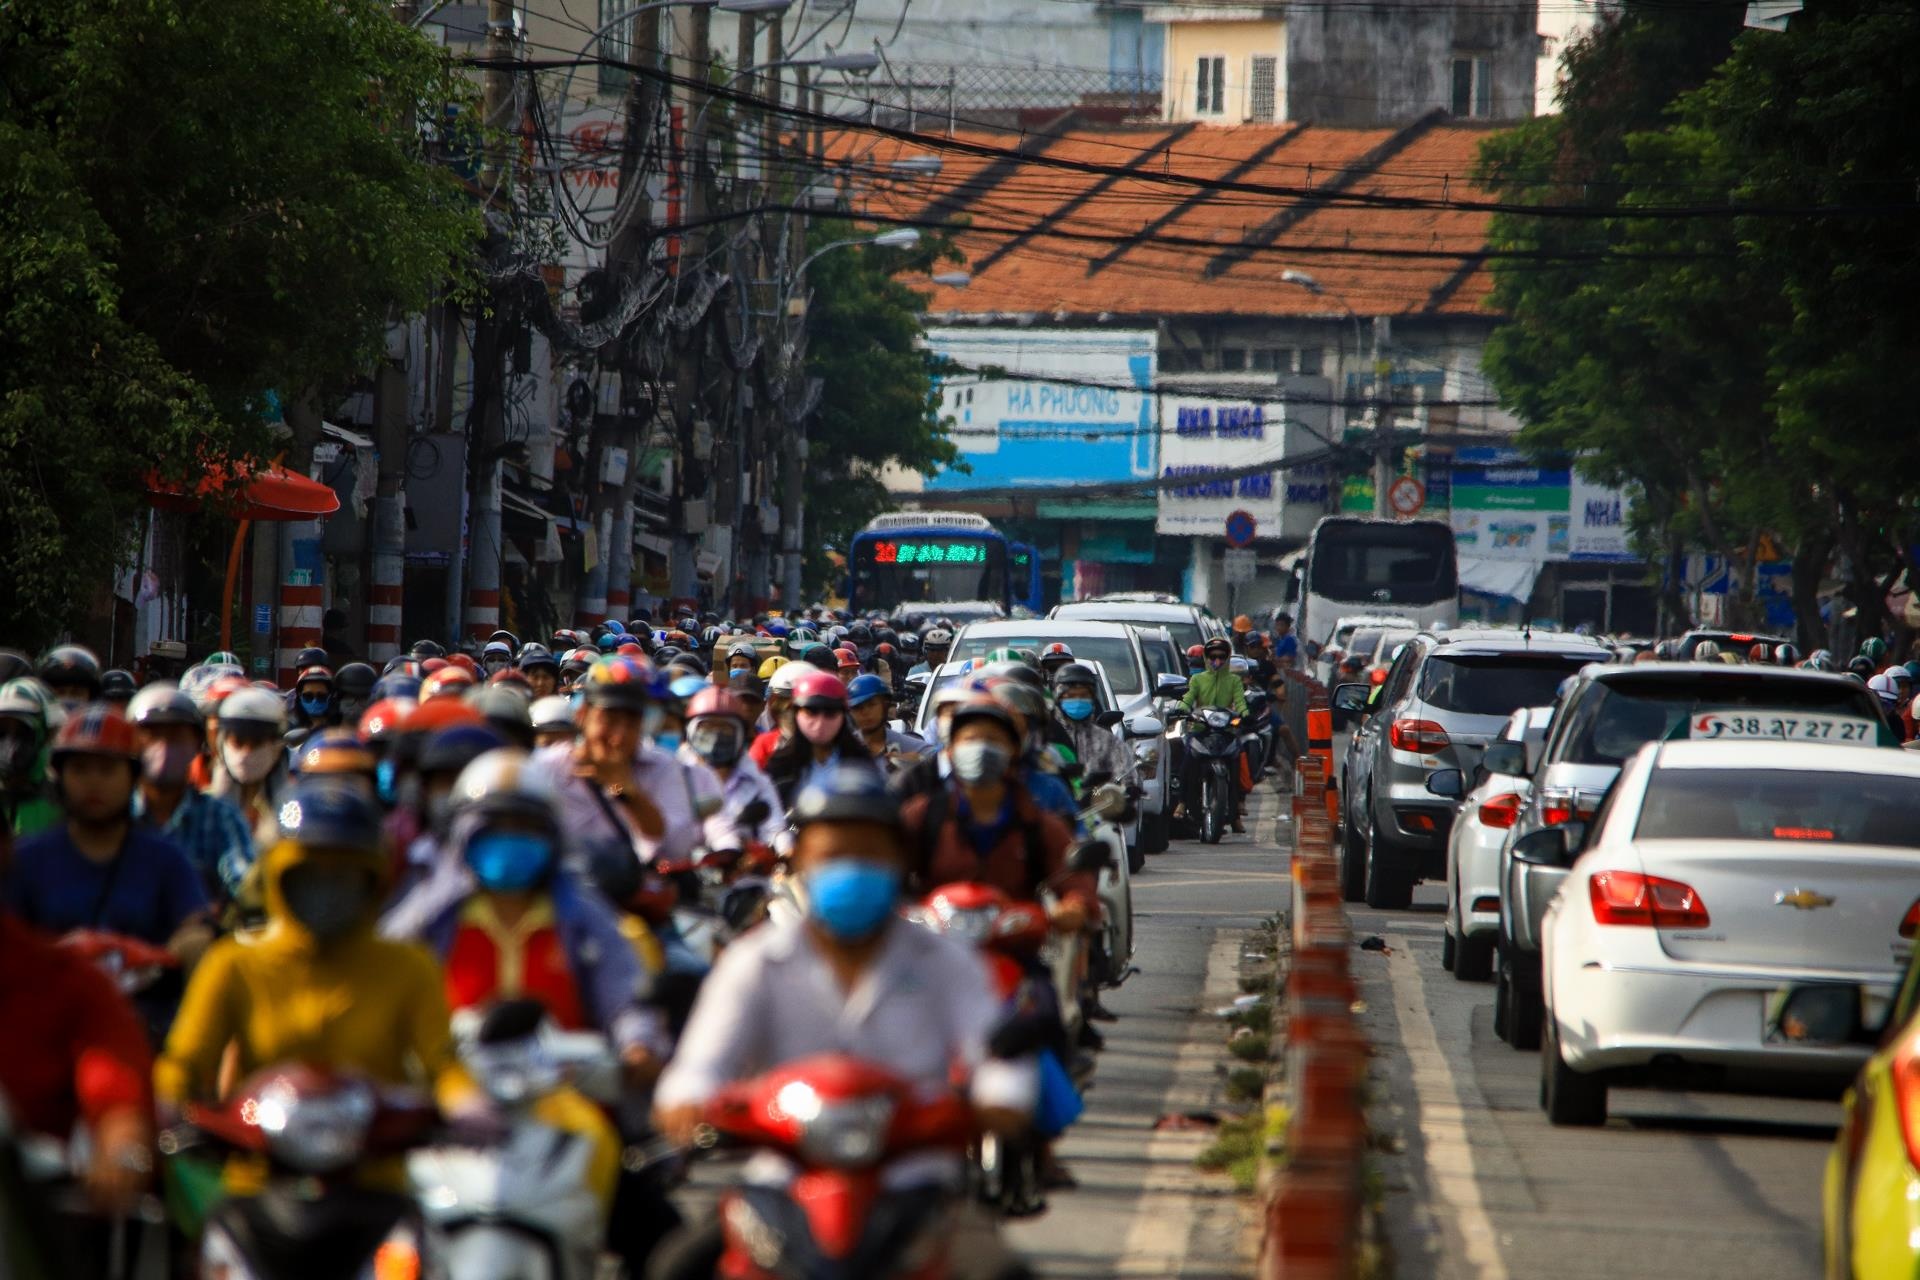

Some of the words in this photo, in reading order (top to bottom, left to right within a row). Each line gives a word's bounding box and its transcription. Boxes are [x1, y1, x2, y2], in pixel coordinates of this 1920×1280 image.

[1731, 717, 1799, 737] 38.27
[1805, 721, 1833, 738] 27
[1841, 723, 1869, 741] 27
